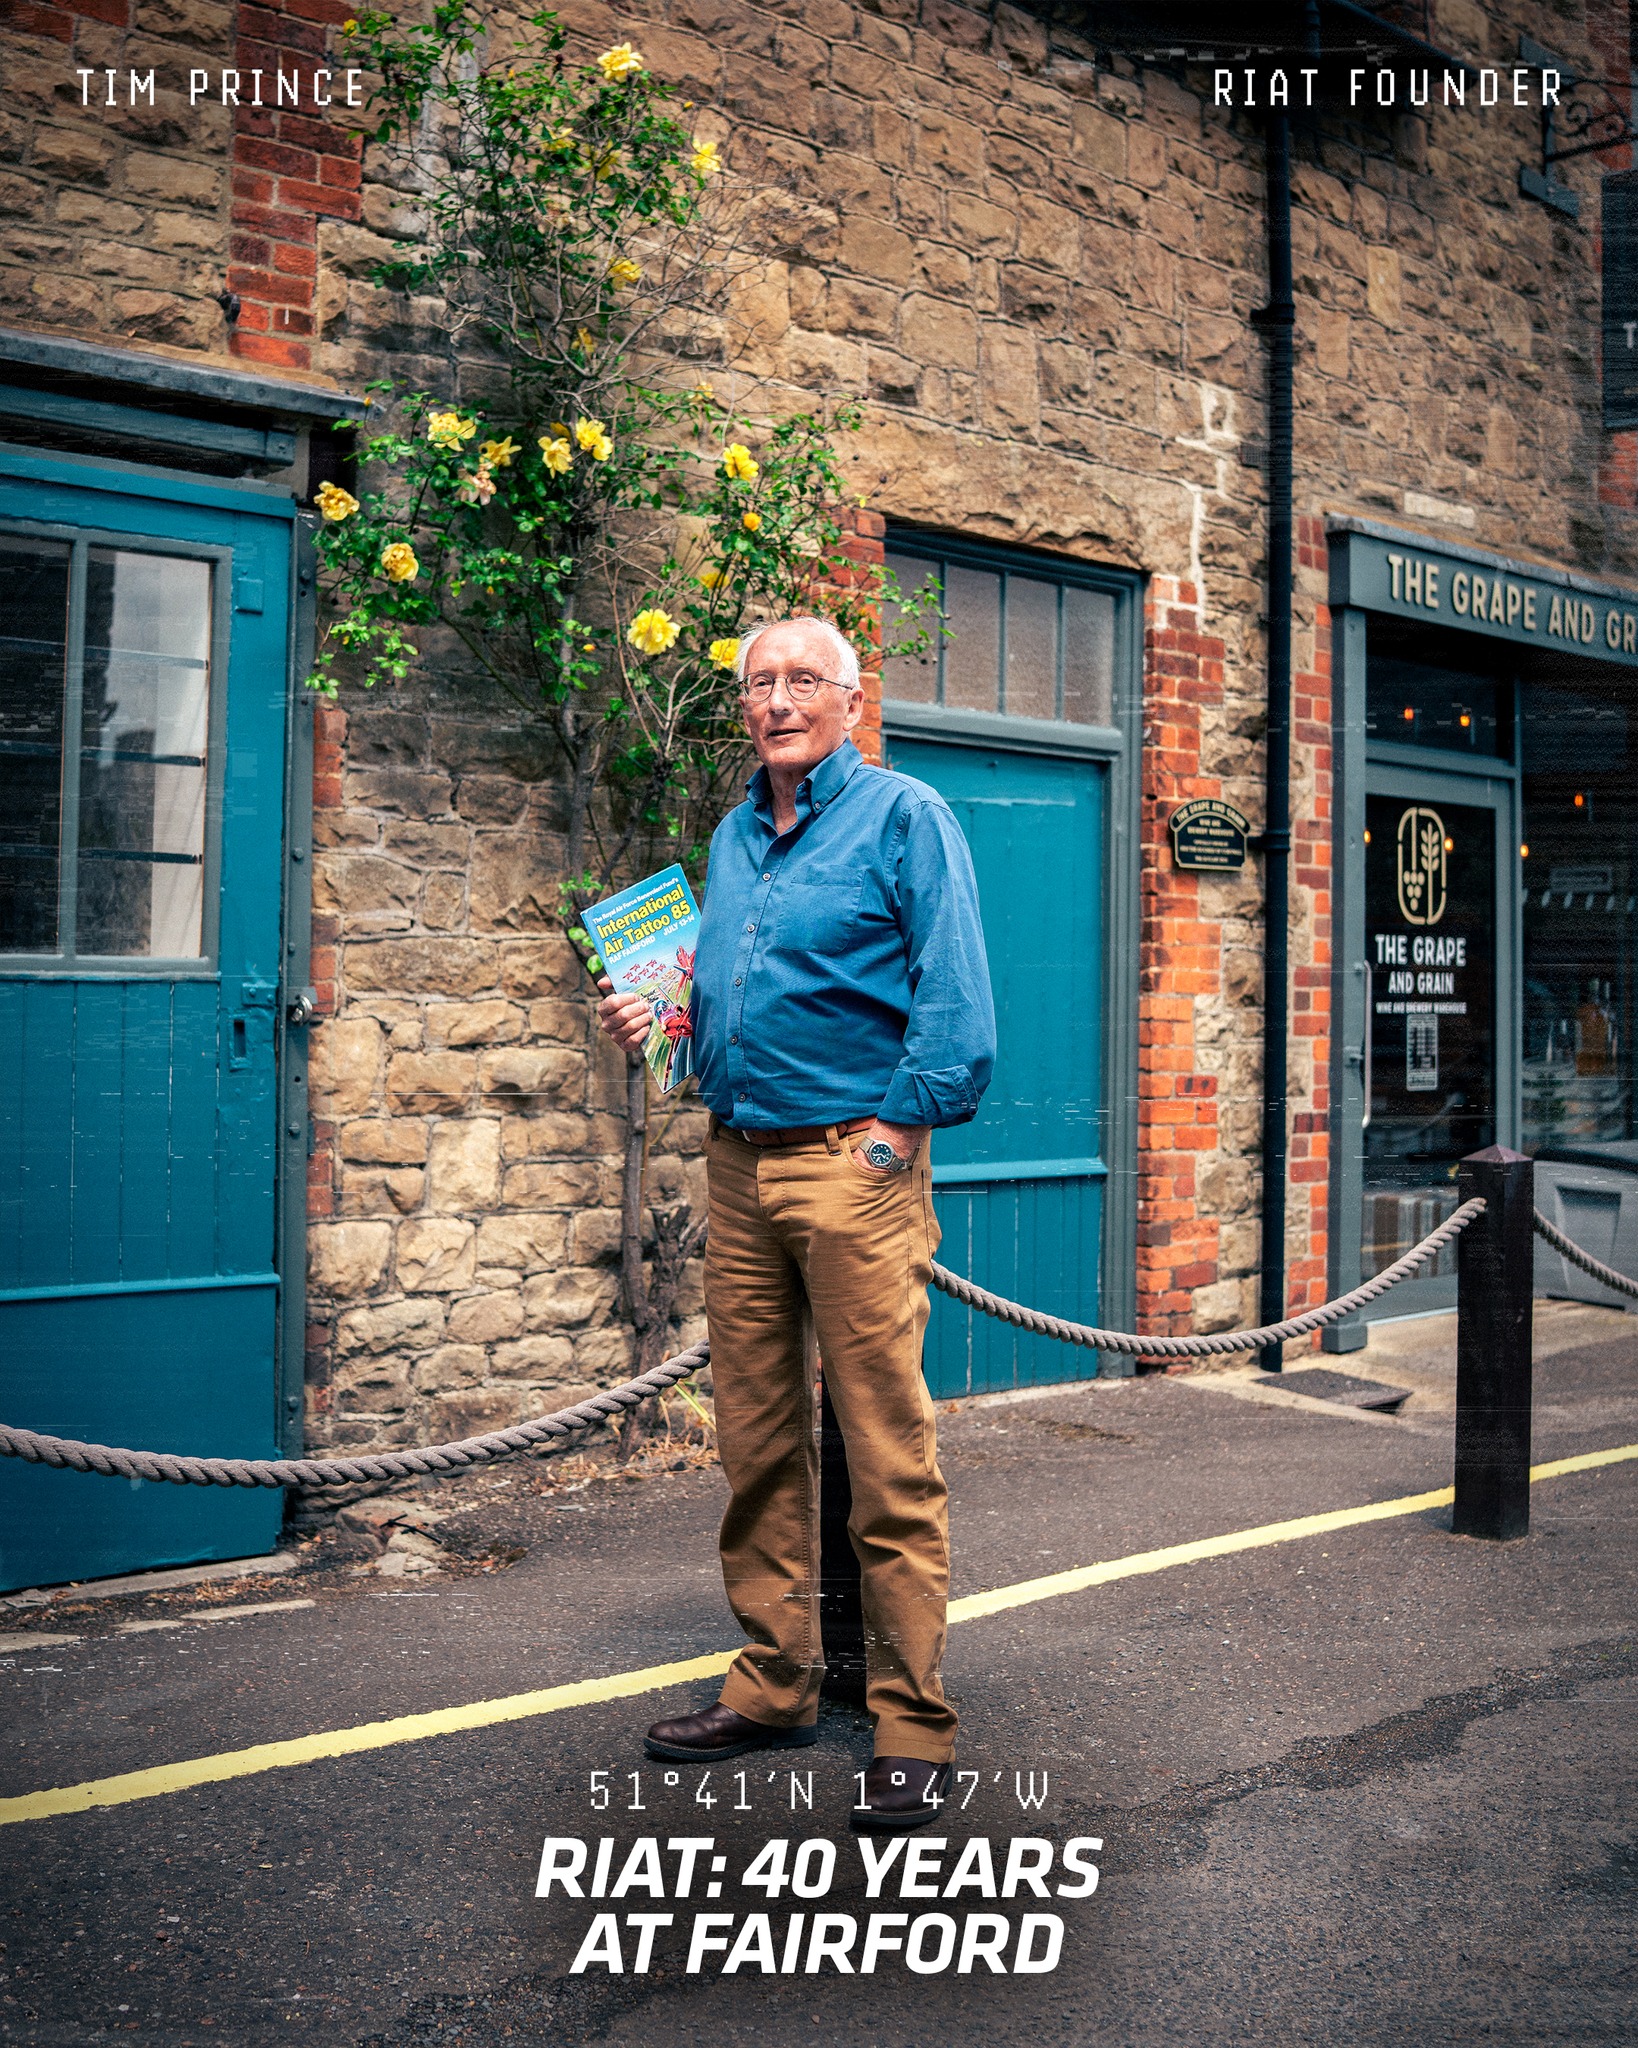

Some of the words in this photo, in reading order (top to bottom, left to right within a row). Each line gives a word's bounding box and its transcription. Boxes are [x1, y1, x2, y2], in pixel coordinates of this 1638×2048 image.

[1387, 553, 1440, 609] THE
[1452, 571, 1537, 631] GRAPE
[1547, 595, 1596, 645] AND
[1176, 808, 1189, 823] THE
[1188, 801, 1210, 815] GRAPE
[1212, 801, 1225, 814] AND
[596, 883, 685, 940] International
[622, 899, 638, 909] Force
[604, 937, 624, 957] Air
[623, 914, 670, 944] Tattoo
[670, 900, 691, 920] 85
[663, 922, 679, 936] JULY
[608, 953, 623, 964] RAF
[622, 935, 656, 958] FAIRFORD
[1375, 934, 1408, 965] THE
[1413, 936, 1467, 967] GRAPE
[1388, 970, 1415, 994] AND
[1417, 972, 1454, 994] GRAIN
[1376, 1002, 1392, 1014] WINE
